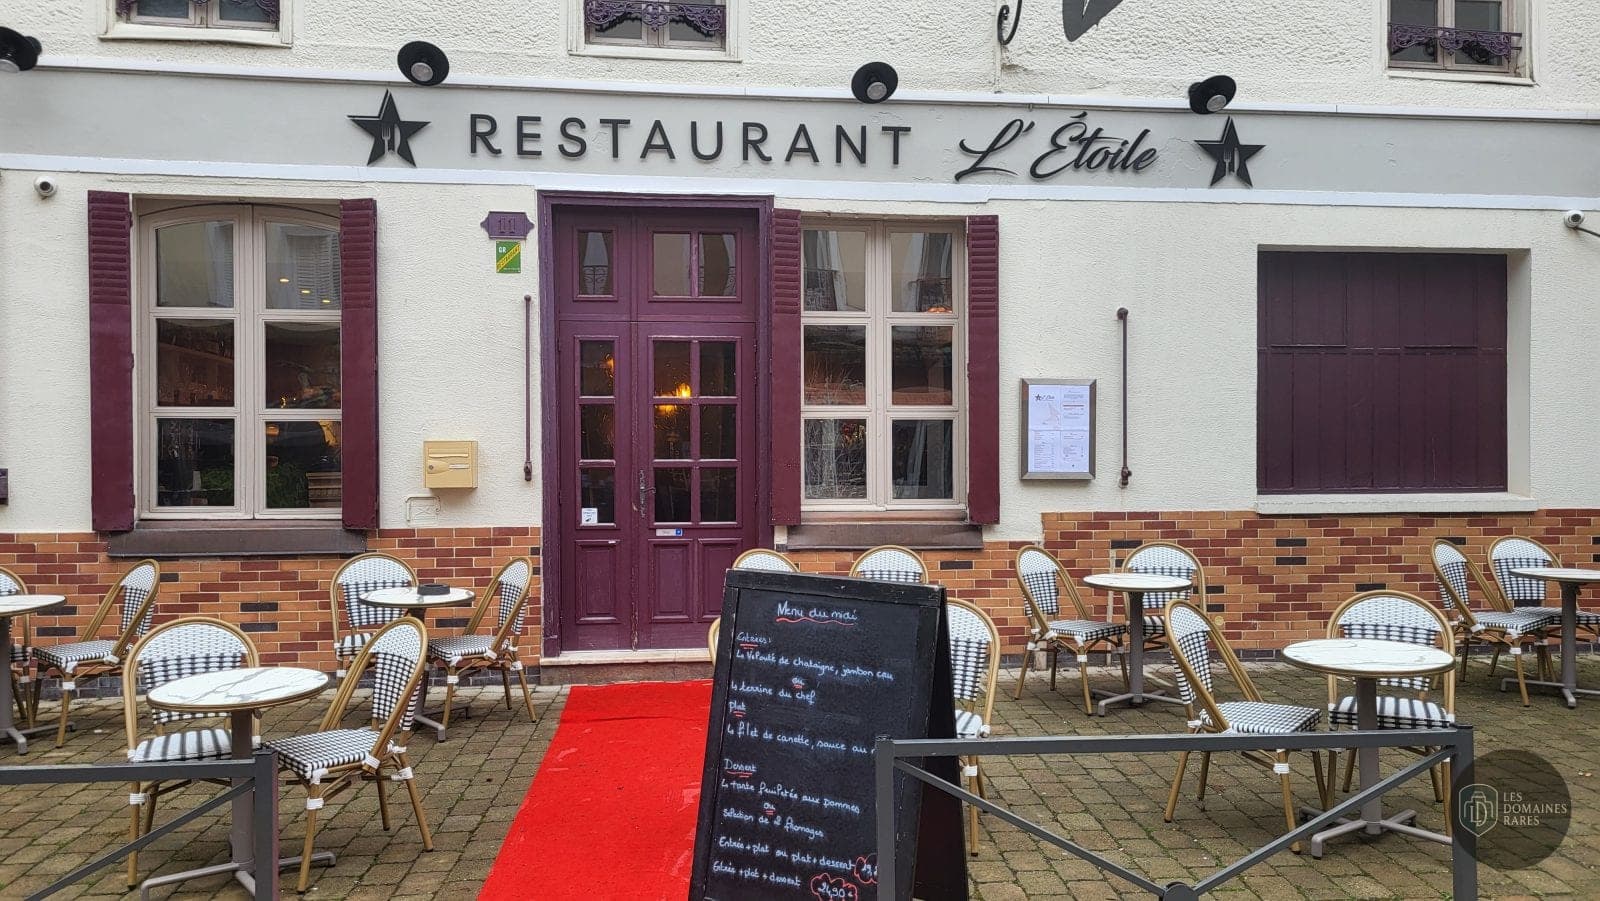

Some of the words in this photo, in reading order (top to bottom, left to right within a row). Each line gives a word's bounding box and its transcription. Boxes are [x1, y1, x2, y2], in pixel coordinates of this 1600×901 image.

[470, 113, 911, 165] RESTAURANT
[498, 216, 516, 233] 11
[498, 246, 507, 254] GR
[777, 601, 803, 616] Menu
[809, 603, 828, 618] du
[832, 605, 858, 620] midi
[778, 655, 790, 665] de
[841, 664, 874, 677] jambon
[739, 681, 773, 695] terrine
[779, 688, 792, 698] du
[796, 690, 816, 705] chef
[737, 721, 759, 738] filet
[763, 729, 773, 740] de
[816, 740, 846, 751] sauce
[852, 745, 867, 754] au
[724, 758, 757, 772] Dessert
[730, 780, 755, 791] tarte
[802, 795, 820, 804] aux
[823, 798, 860, 816] pommes
[759, 815, 769, 824] de
[773, 815, 781, 826] 2
[784, 816, 824, 840] fromages
[775, 849, 788, 858] ou
